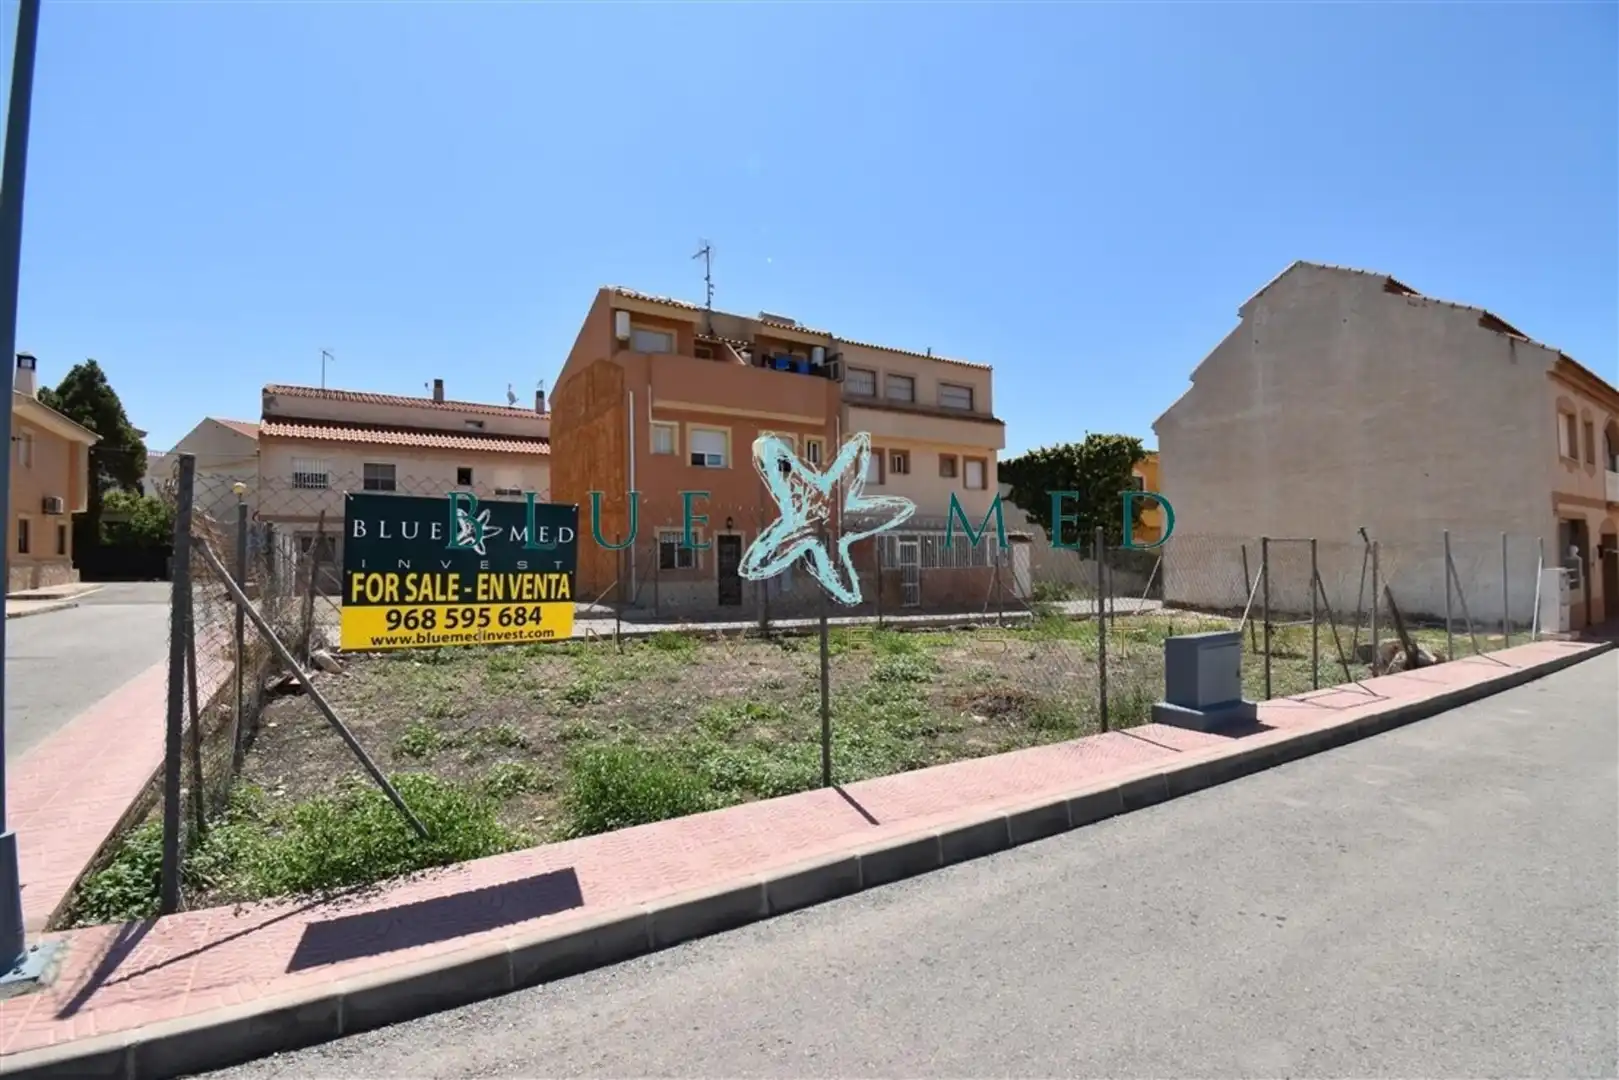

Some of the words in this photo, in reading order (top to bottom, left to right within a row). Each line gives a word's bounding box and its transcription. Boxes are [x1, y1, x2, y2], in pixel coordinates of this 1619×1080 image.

[353, 519, 442, 540] BLUE
[509, 525, 574, 543] MED
[361, 558, 563, 571] INVEST
[352, 572, 400, 603] FOR
[404, 572, 460, 602] SALE
[477, 573, 504, 601] EN
[508, 572, 571, 600] VENTA
[385, 608, 436, 632] 968
[444, 607, 491, 629] 595
[498, 606, 542, 628] 684
